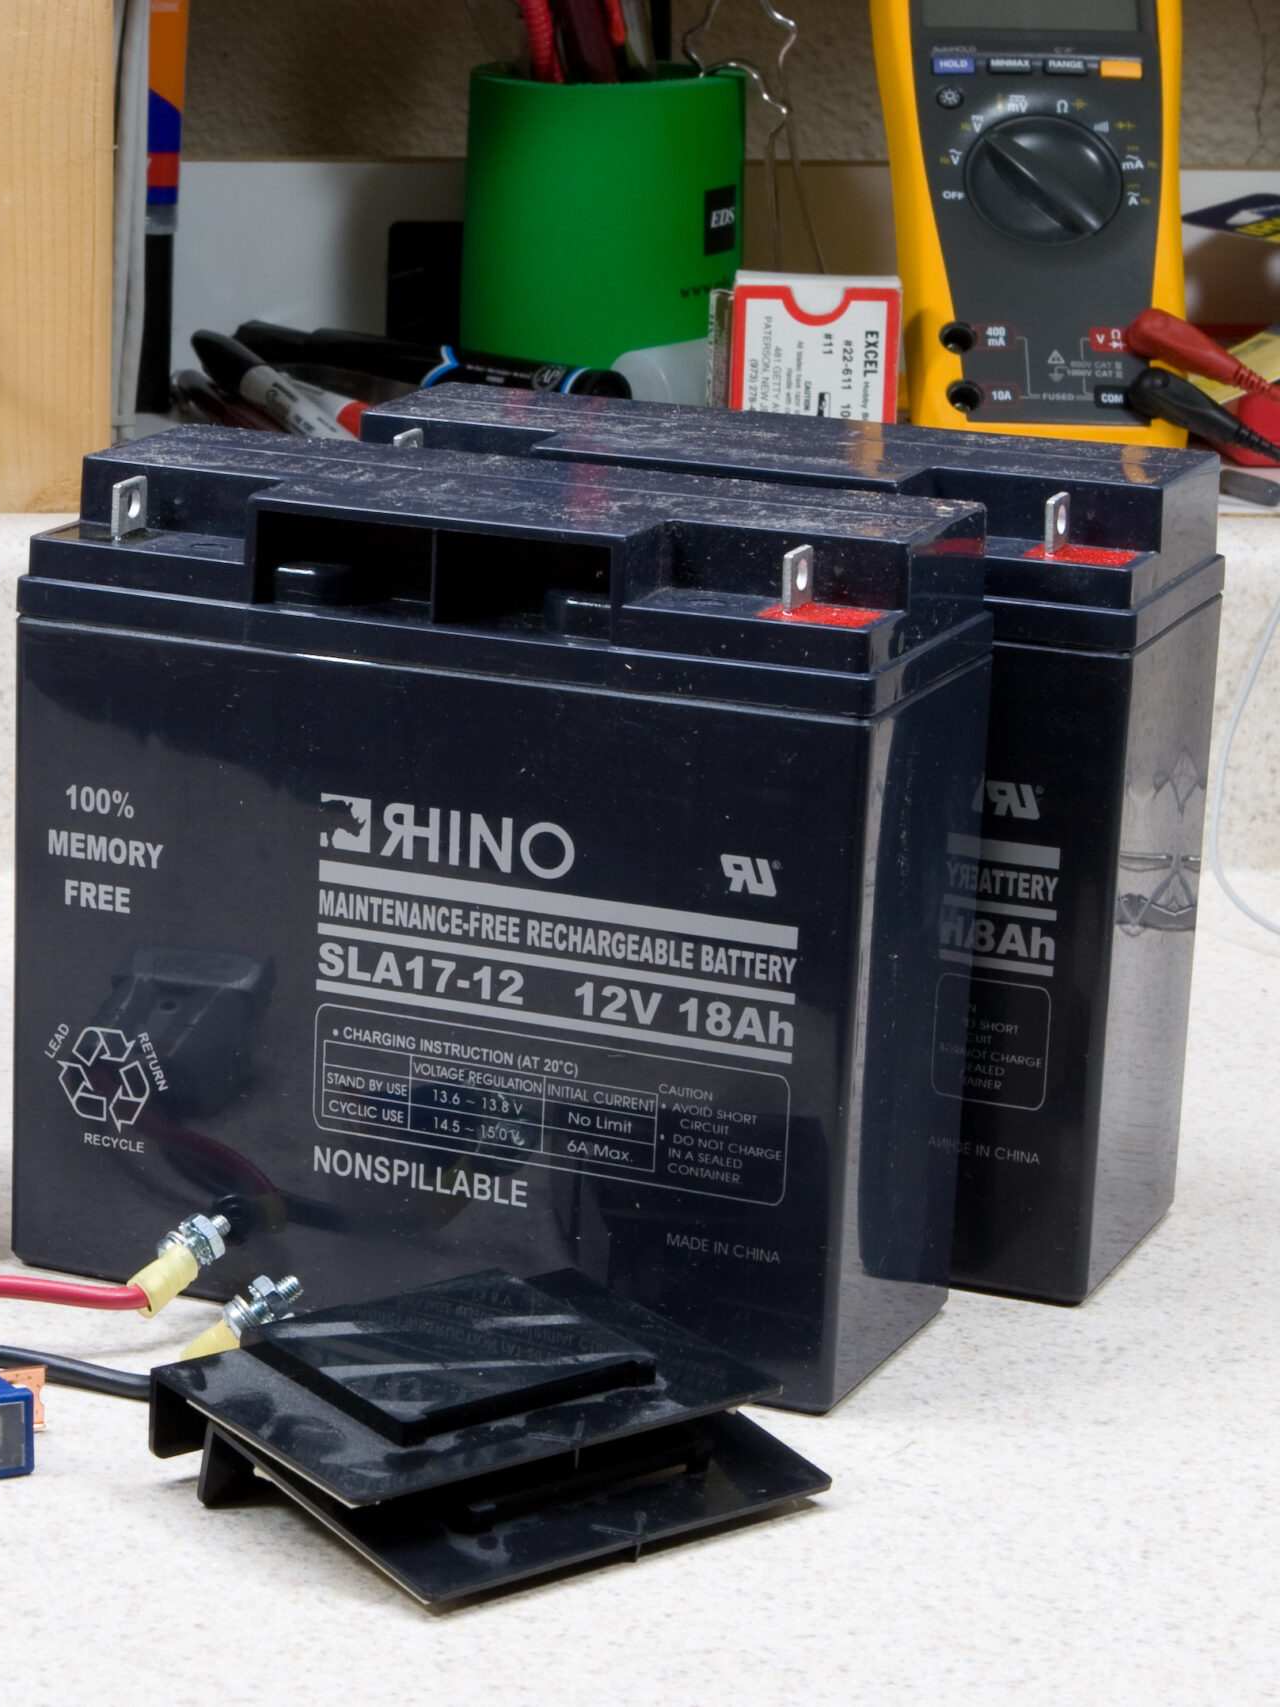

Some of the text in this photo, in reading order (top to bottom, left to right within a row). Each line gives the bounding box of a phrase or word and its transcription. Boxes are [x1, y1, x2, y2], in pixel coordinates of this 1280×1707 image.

[939, 60, 968, 69] HOLD
[990, 59, 1030, 68] MINMAX
[1048, 60, 1083, 69] RANGE
[942, 191, 965, 200] OFF
[710, 205, 736, 229] EDS
[986, 326, 1006, 337] 400
[987, 337, 1006, 347] mA
[822, 333, 833, 355] #11
[760, 316, 773, 399] PATERSON, NEW
[795, 351, 803, 371] blades
[841, 340, 854, 390] #22-611
[860, 330, 879, 409] EXCEL Hobby
[748, 358, 759, 382] (973)
[772, 345, 783, 400] 481 GETTY
[803, 381, 812, 411] CAUTION
[992, 390, 1011, 401] 10A
[1042, 393, 1074, 401] FUSED
[1101, 392, 1124, 403] COM
[65, 784, 135, 819] 100%
[48, 829, 164, 869] MEMORY
[380, 802, 575, 880] RHINO
[64, 879, 131, 914] FREE
[318, 888, 797, 984] MAINTENANCE-FREE RECHARGEABLE BATTERY
[318, 941, 795, 1047] SLA17-12 12V 18Ah
[980, 1021, 1019, 1035] SHORT
[44, 1023, 70, 1059] LEAD
[343, 1026, 579, 1079] CHARGING INSTRUCTION (AT 20°C)
[138, 1032, 168, 1092] RETURN
[991, 1051, 1043, 1069] CHARGE
[326, 1072, 408, 1097] STAND BY USE
[413, 1061, 542, 1094] VOLTAGE REGULATION
[433, 1089, 509, 1114] 13.6 13.8
[547, 1083, 656, 1113] INITIAL CURRENT
[658, 1083, 713, 1101] CAUTION
[328, 1099, 405, 1124] CYCLIC USE
[568, 1111, 632, 1134] No Limit
[672, 1102, 757, 1125] AVOID SHORT
[433, 1116, 460, 1133] 14.5
[680, 1118, 729, 1136] CIRCUIT
[84, 1132, 145, 1153] RECYCLE
[567, 1140, 634, 1163] 6A Max.
[673, 1134, 782, 1161] DO NOT CHARGE
[668, 1148, 743, 1170] IN A SEALED
[976, 1145, 1040, 1165] IN CHINA
[313, 1145, 528, 1208] NONSPILLABLE
[667, 1233, 780, 1265] MADE IN CHINA
